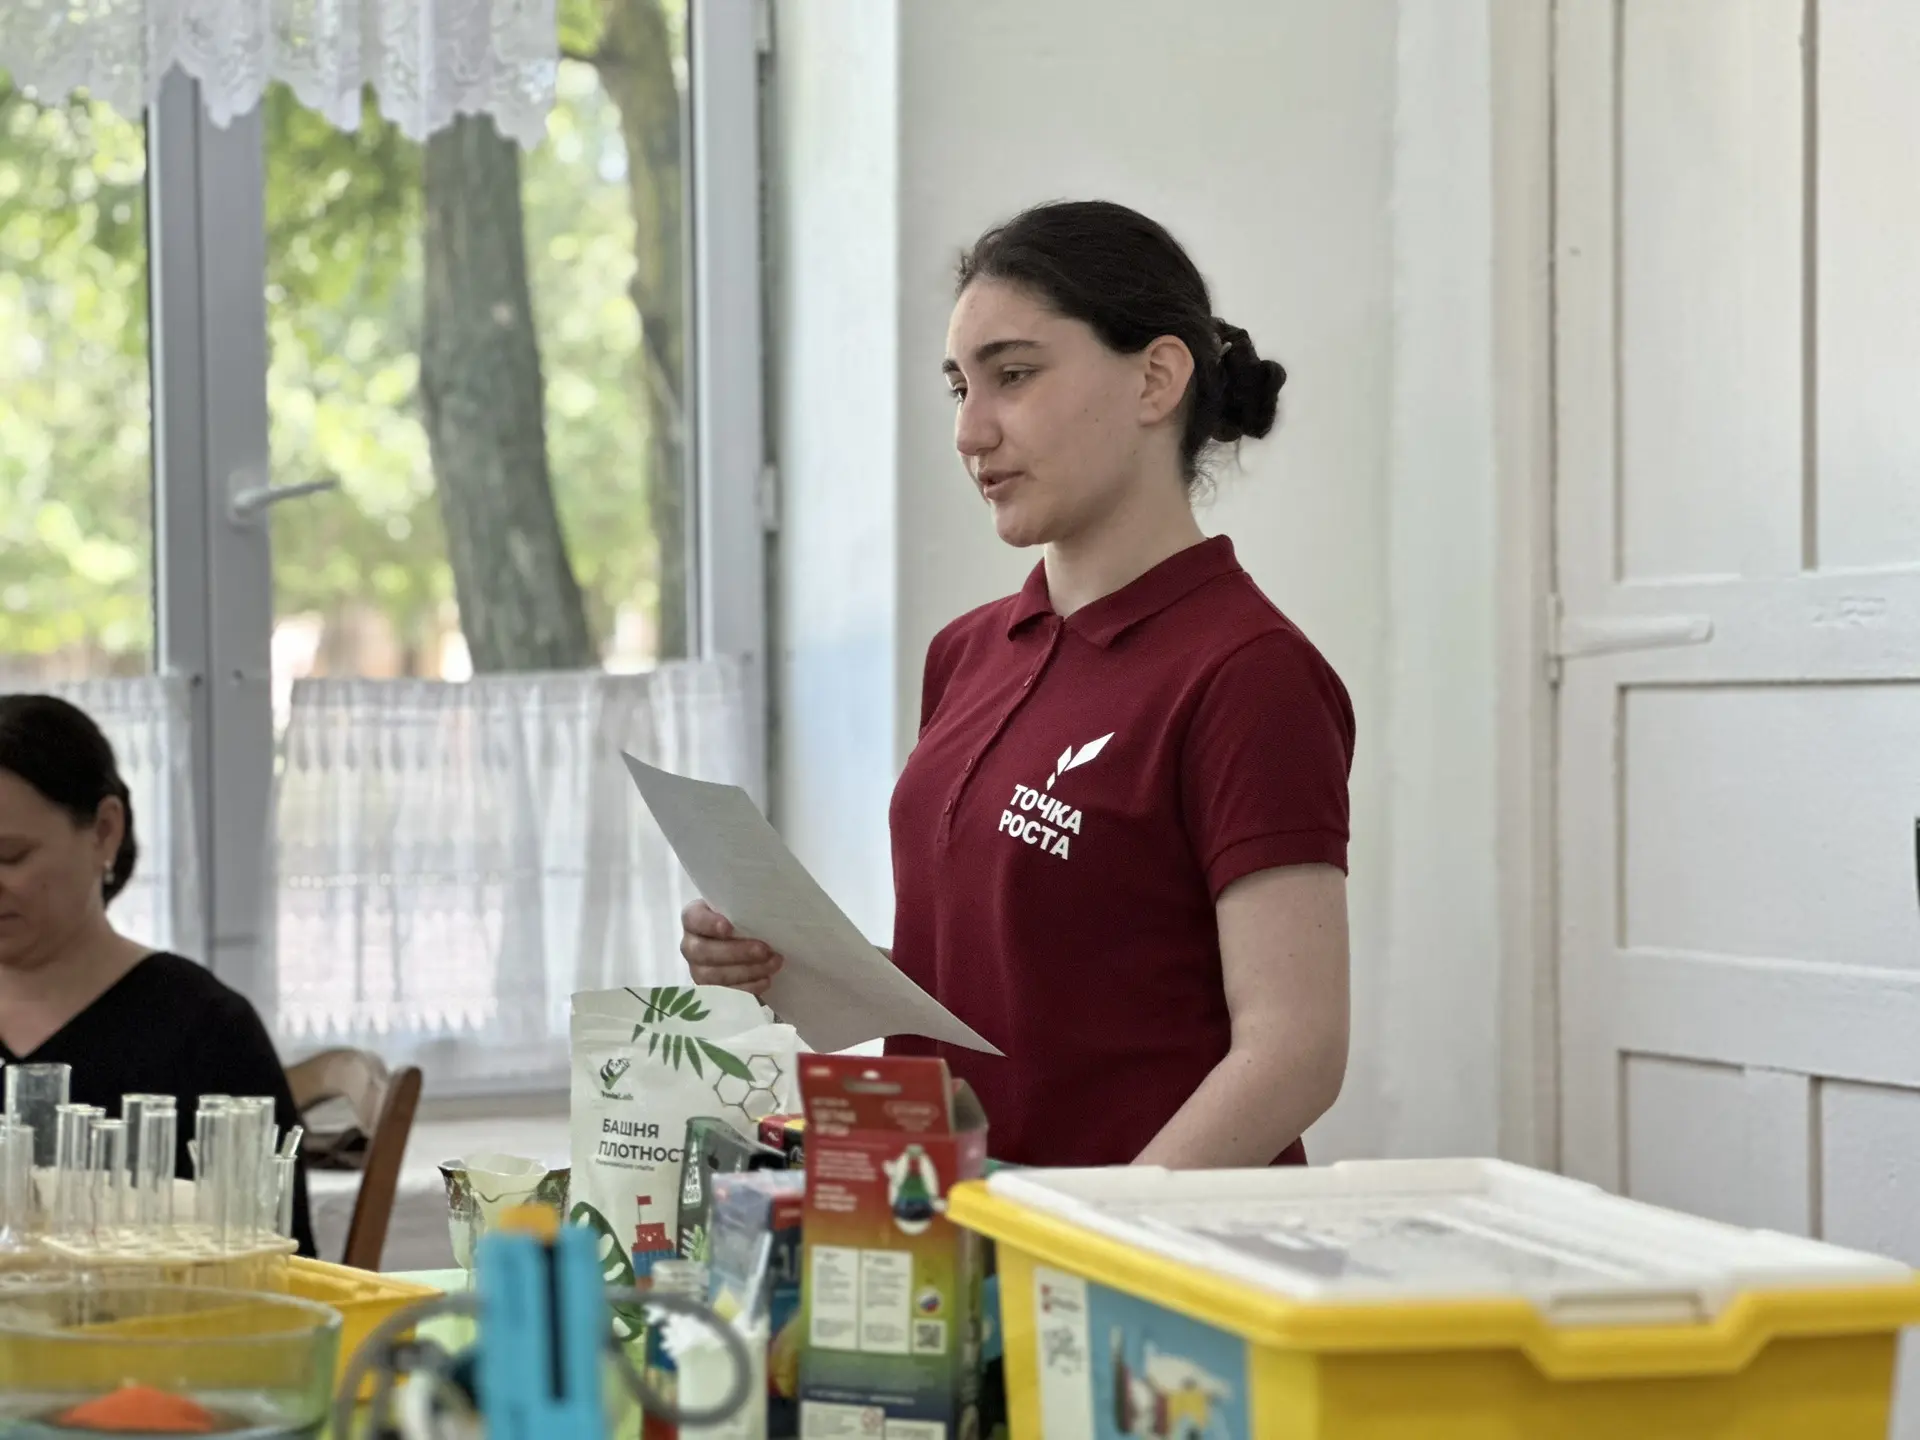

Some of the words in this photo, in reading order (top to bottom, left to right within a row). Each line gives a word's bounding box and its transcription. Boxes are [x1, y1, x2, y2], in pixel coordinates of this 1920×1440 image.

[998, 809, 1070, 860] РОСТА
[1010, 784, 1082, 835] ТОЧКА
[602, 1118, 659, 1138] БАШНЯ
